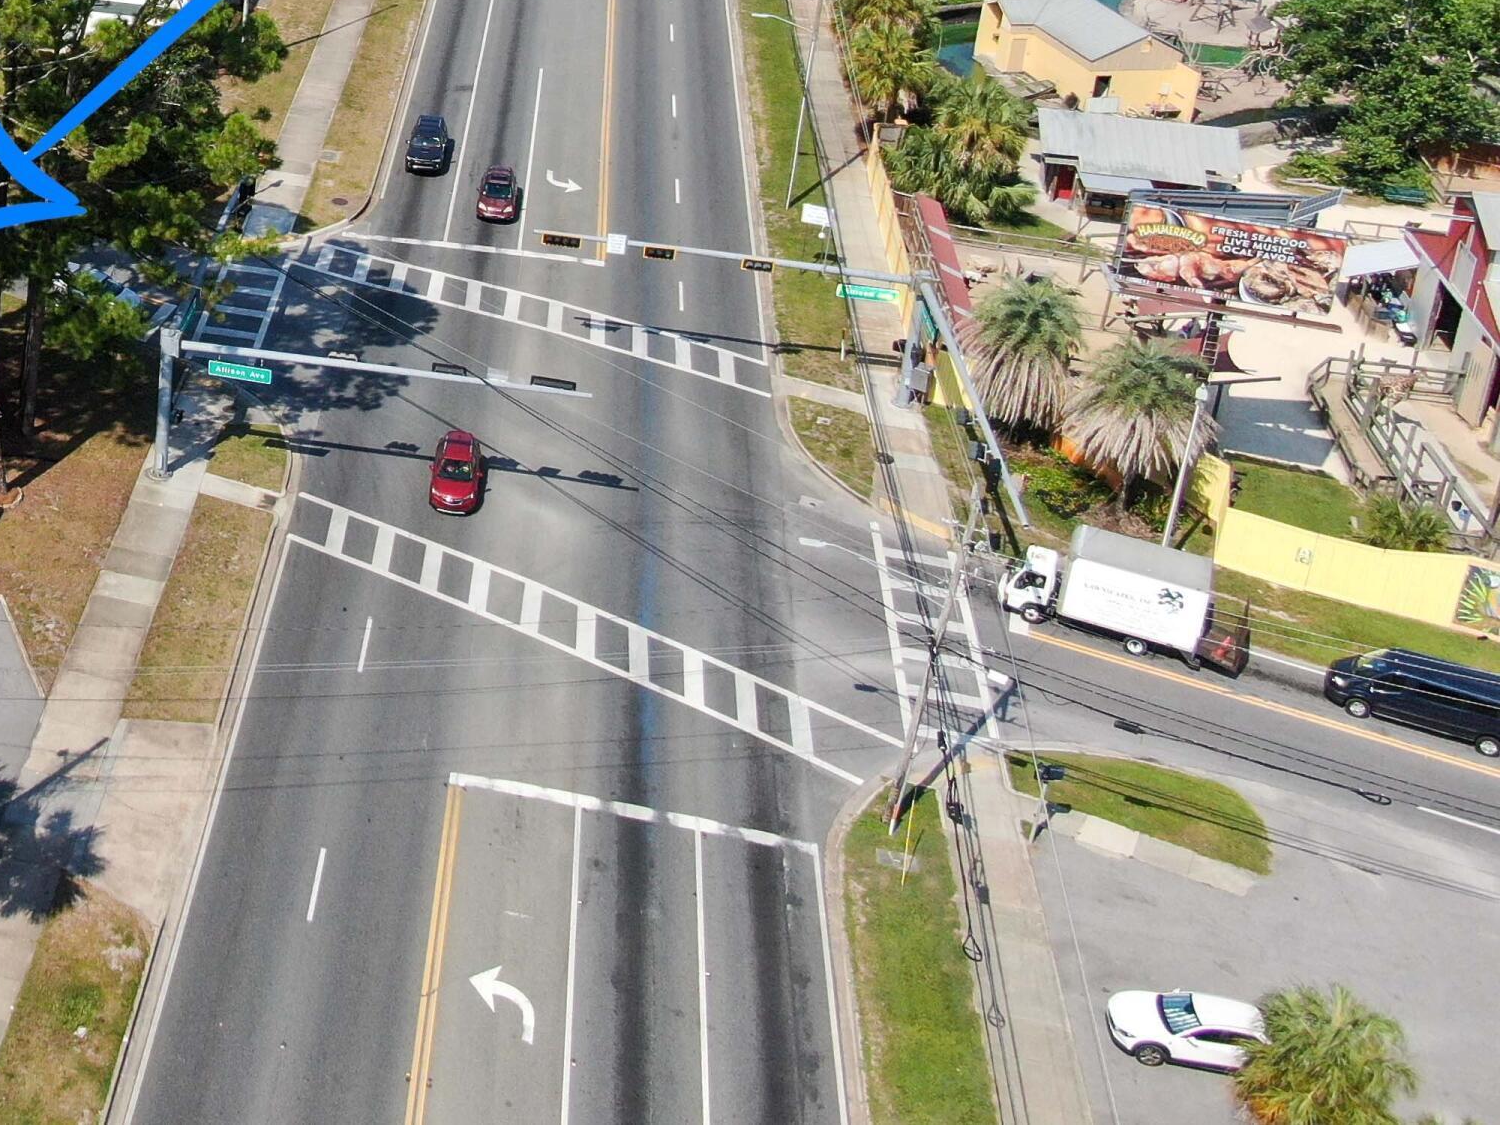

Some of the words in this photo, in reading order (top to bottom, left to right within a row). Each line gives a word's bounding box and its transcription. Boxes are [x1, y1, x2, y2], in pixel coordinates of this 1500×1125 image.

[1137, 225, 1206, 246] HAMMERHEAD
[1211, 226, 1248, 240] FRESH
[1251, 231, 1311, 250] SEAFOOD.
[1224, 236, 1251, 249] LIVE
[1252, 241, 1294, 256] MUSIC.
[1216, 243, 1254, 258] LOCAL
[1256, 249, 1299, 265] FAVOR.
[215, 365, 246, 377] Allison
[249, 370, 265, 380] Ave
